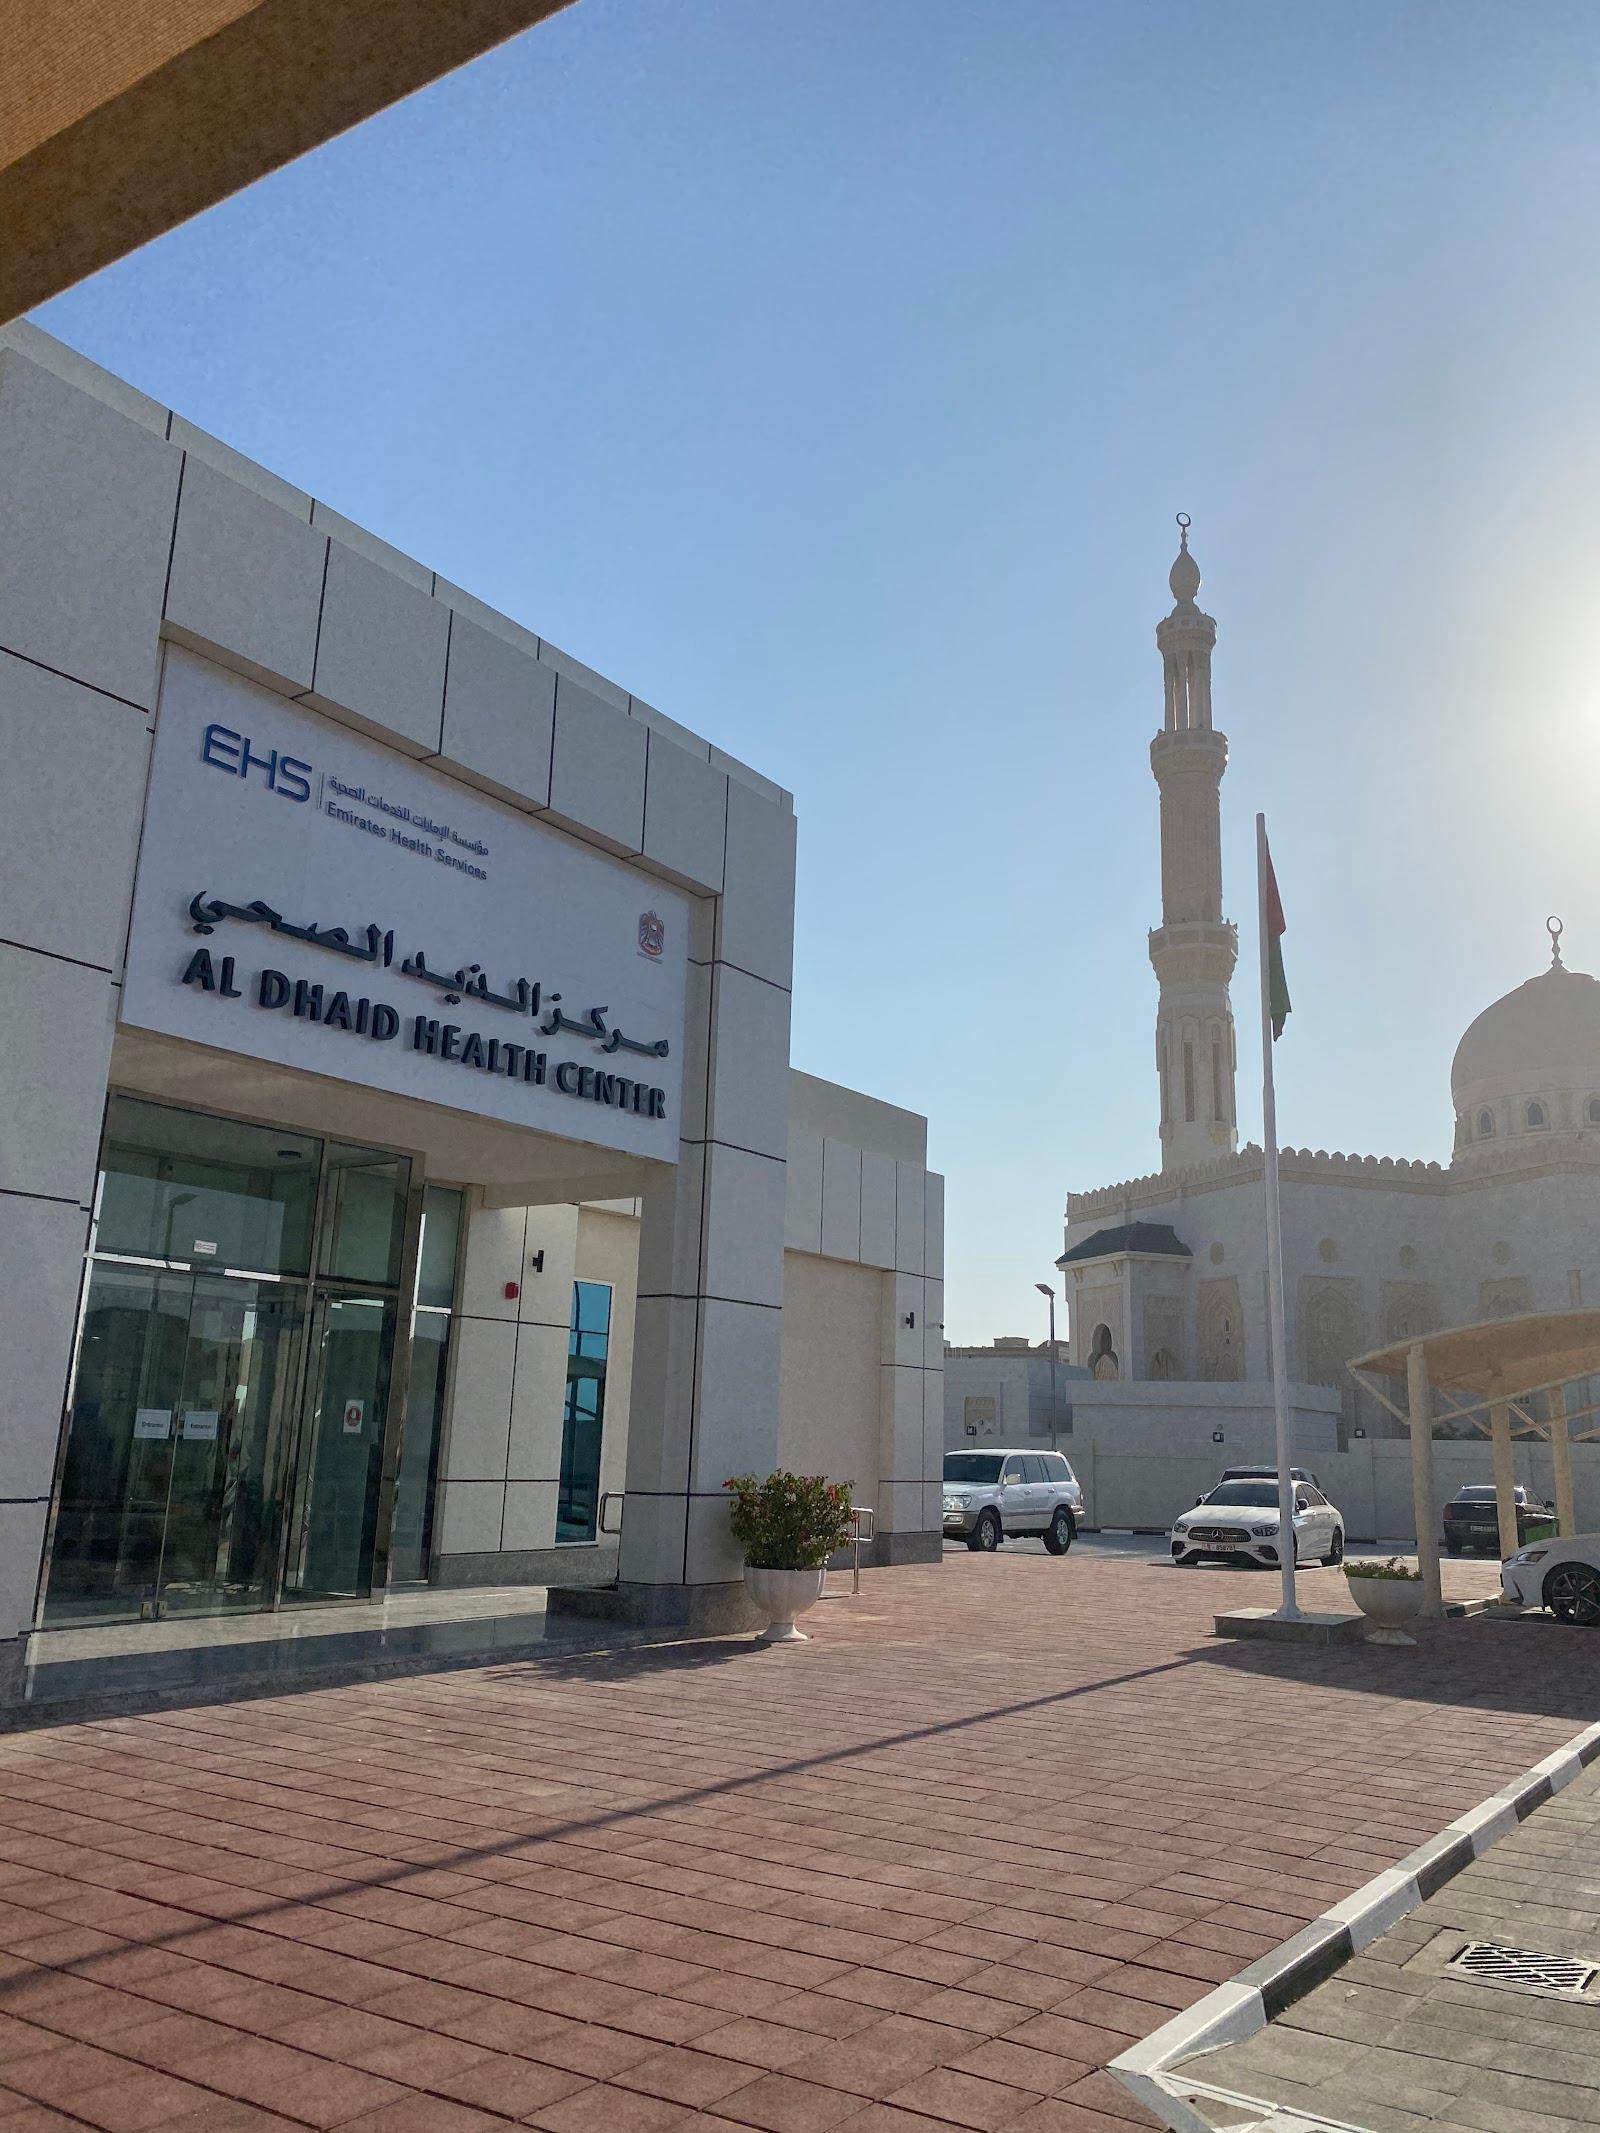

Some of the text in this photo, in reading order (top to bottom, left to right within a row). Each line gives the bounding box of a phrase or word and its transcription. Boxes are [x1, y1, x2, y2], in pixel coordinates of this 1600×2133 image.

[202, 723, 313, 802] EHS
[326, 800, 487, 880] Emirates Health Services
[328, 775, 489, 856] مؤسسة الإمارات للخدمات الصحية
[188, 890, 669, 1058] مركز الذيد الصحي
[182, 948, 666, 1119] AL DHAID HEALTH CENTER
